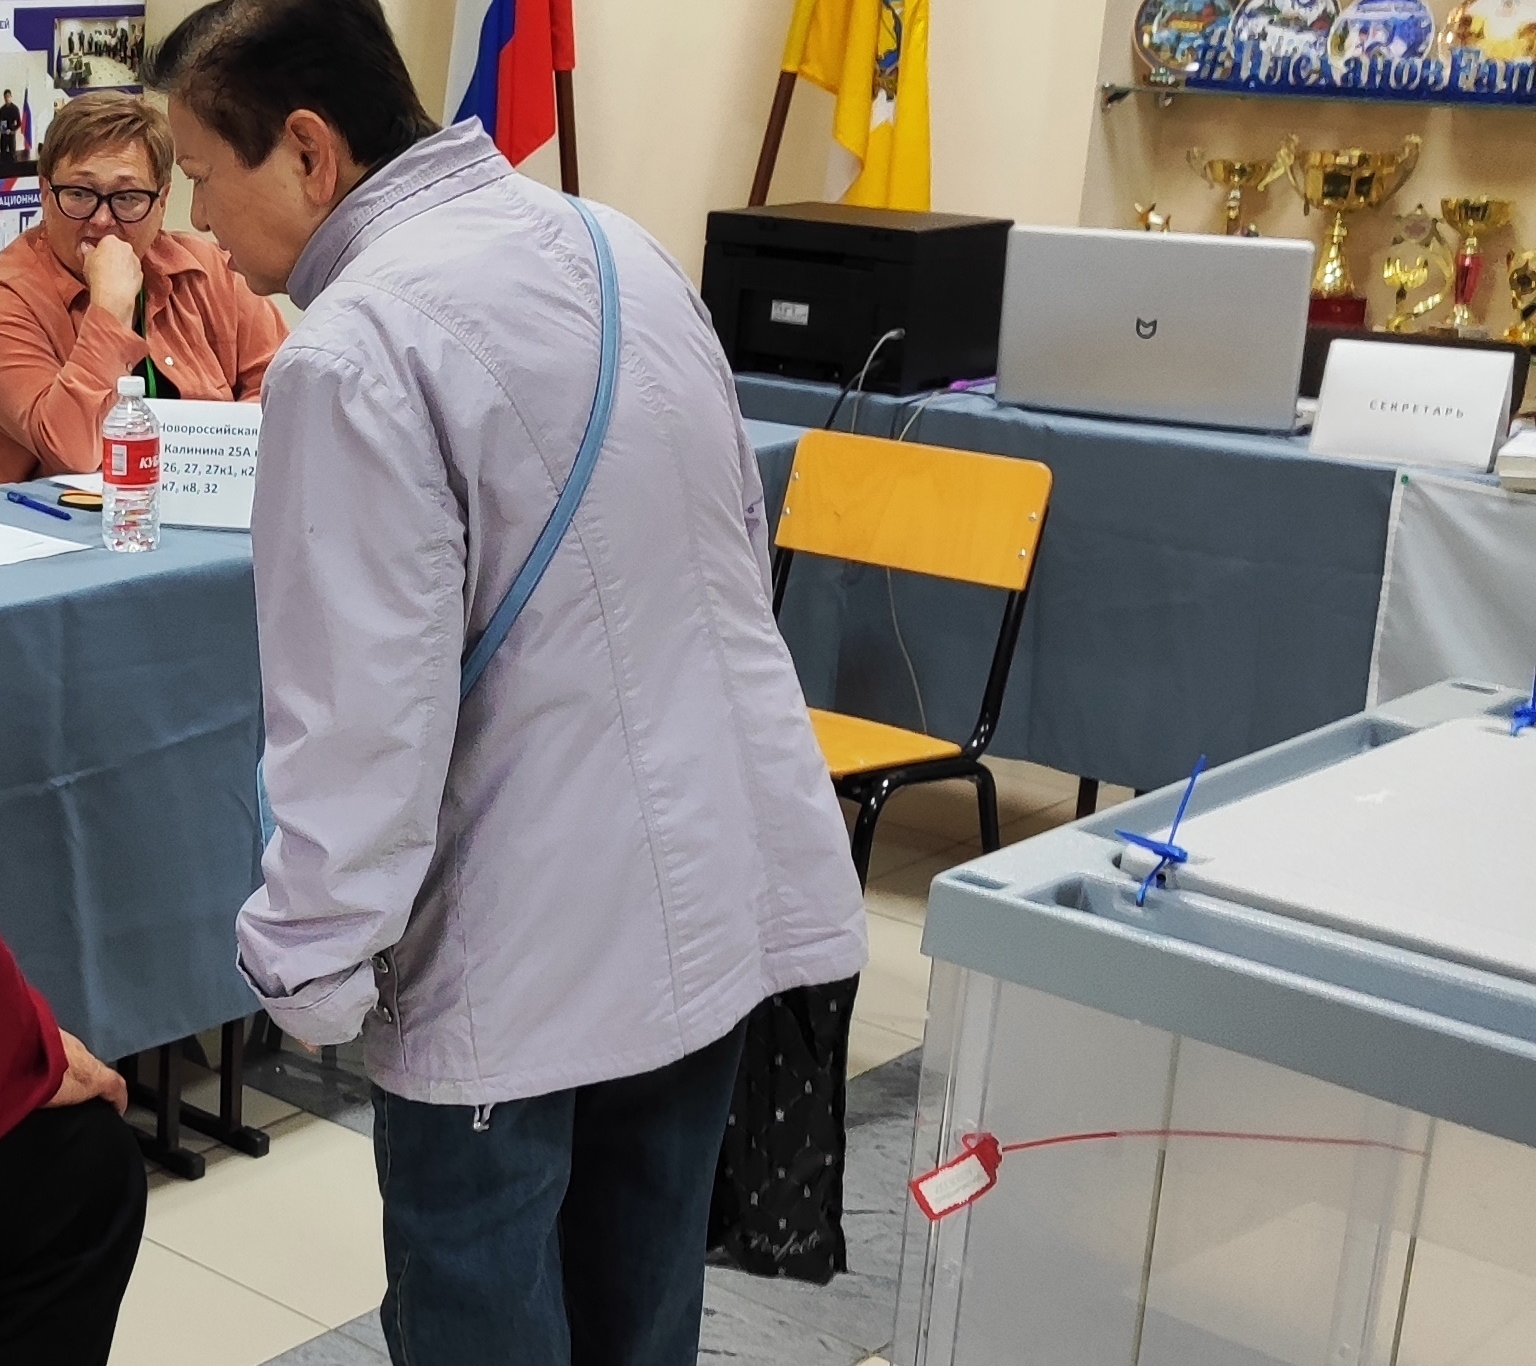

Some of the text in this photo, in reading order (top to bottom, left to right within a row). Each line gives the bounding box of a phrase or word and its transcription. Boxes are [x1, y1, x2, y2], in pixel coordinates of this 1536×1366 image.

[1369, 399, 1465, 419] СЕКРЕТАРЬ
[165, 443, 224, 455] Калинина
[228, 446, 251, 457] 25А
[163, 463, 180, 475] 26,
[184, 464, 202, 476] 27,
[162, 481, 218, 495] к7, к8, 32
